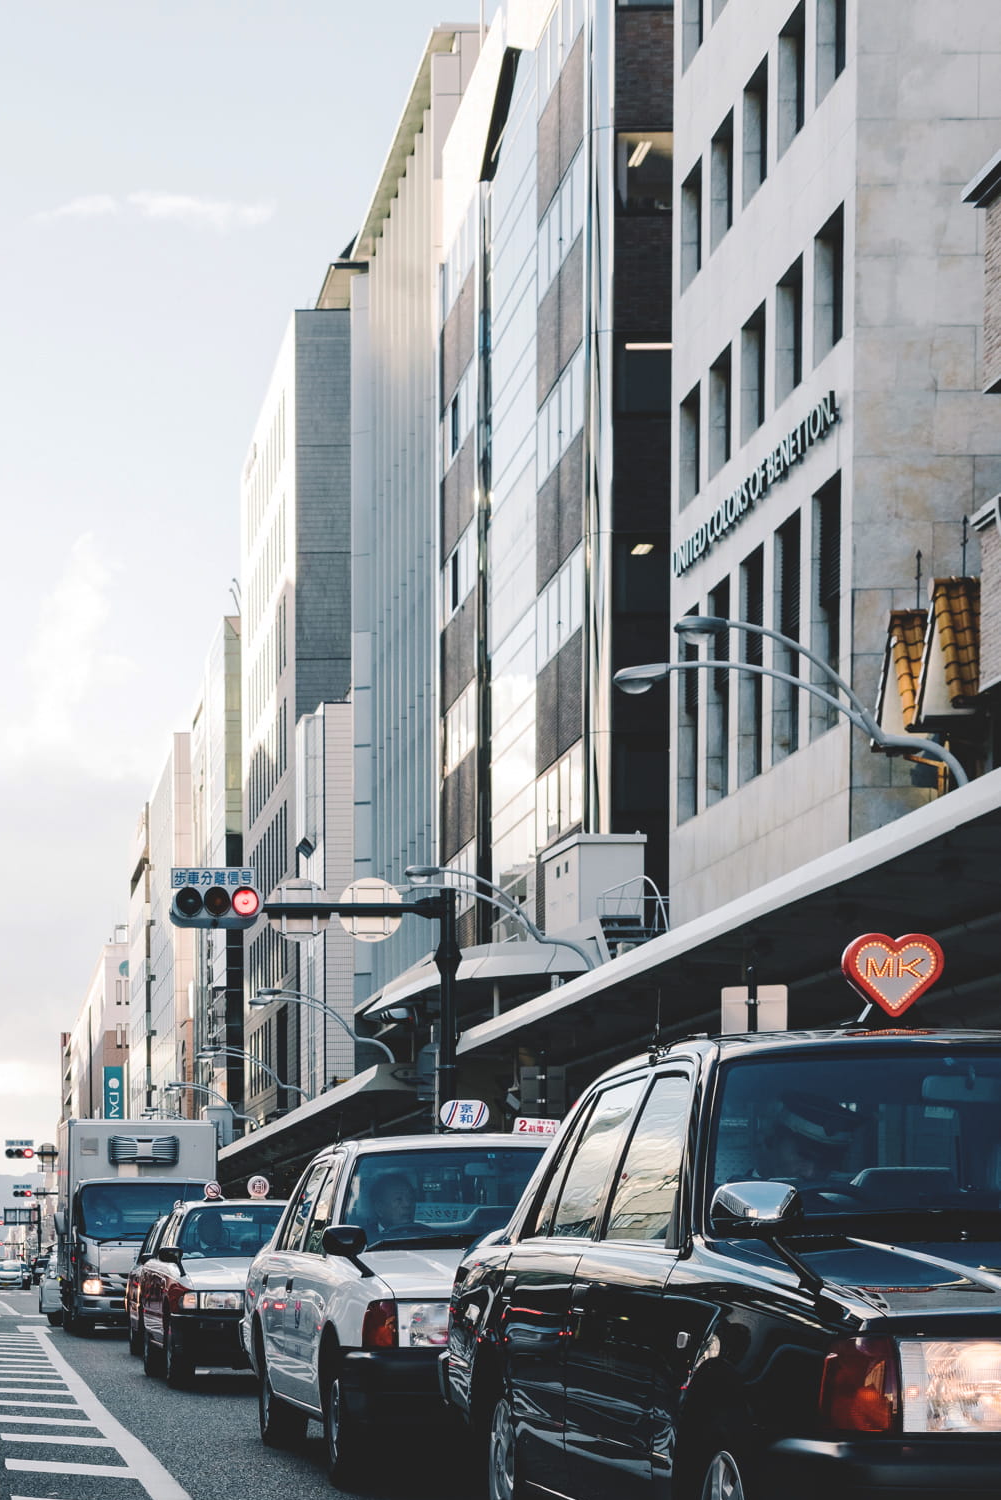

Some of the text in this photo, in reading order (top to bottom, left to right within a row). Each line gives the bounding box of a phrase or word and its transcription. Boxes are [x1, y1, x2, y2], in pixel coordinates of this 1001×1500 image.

[673, 524, 706, 577] UNITED
[707, 480, 749, 543] COLORS
[749, 458, 767, 501] OF
[174, 871, 253, 886] 歩車分離信号
[866, 957, 925, 978] MK
[459, 1103, 474, 1124] 京和
